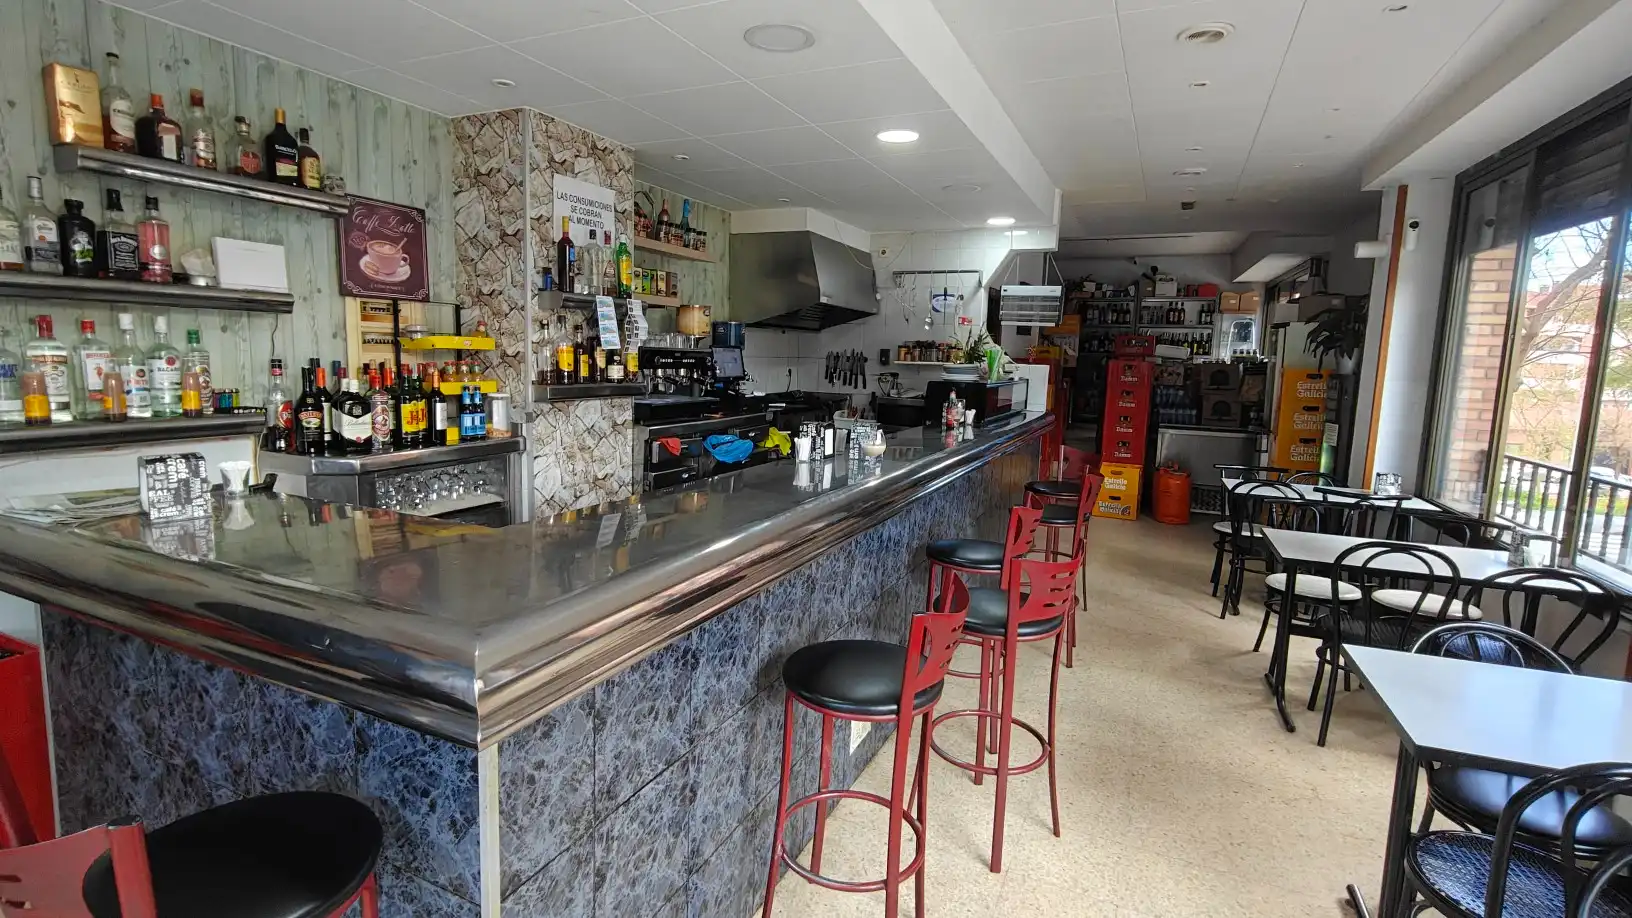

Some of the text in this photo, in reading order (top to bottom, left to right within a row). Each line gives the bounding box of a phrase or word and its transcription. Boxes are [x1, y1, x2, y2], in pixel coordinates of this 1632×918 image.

[556, 191, 613, 212] LAS CONSUMICIONES
[570, 205, 603, 219] SE COBRAN
[568, 215, 605, 230] AL MOMENTO
[1297, 381, 1327, 390] Estrell
[1290, 444, 1319, 453] Estrell
[176, 458, 189, 479] café
